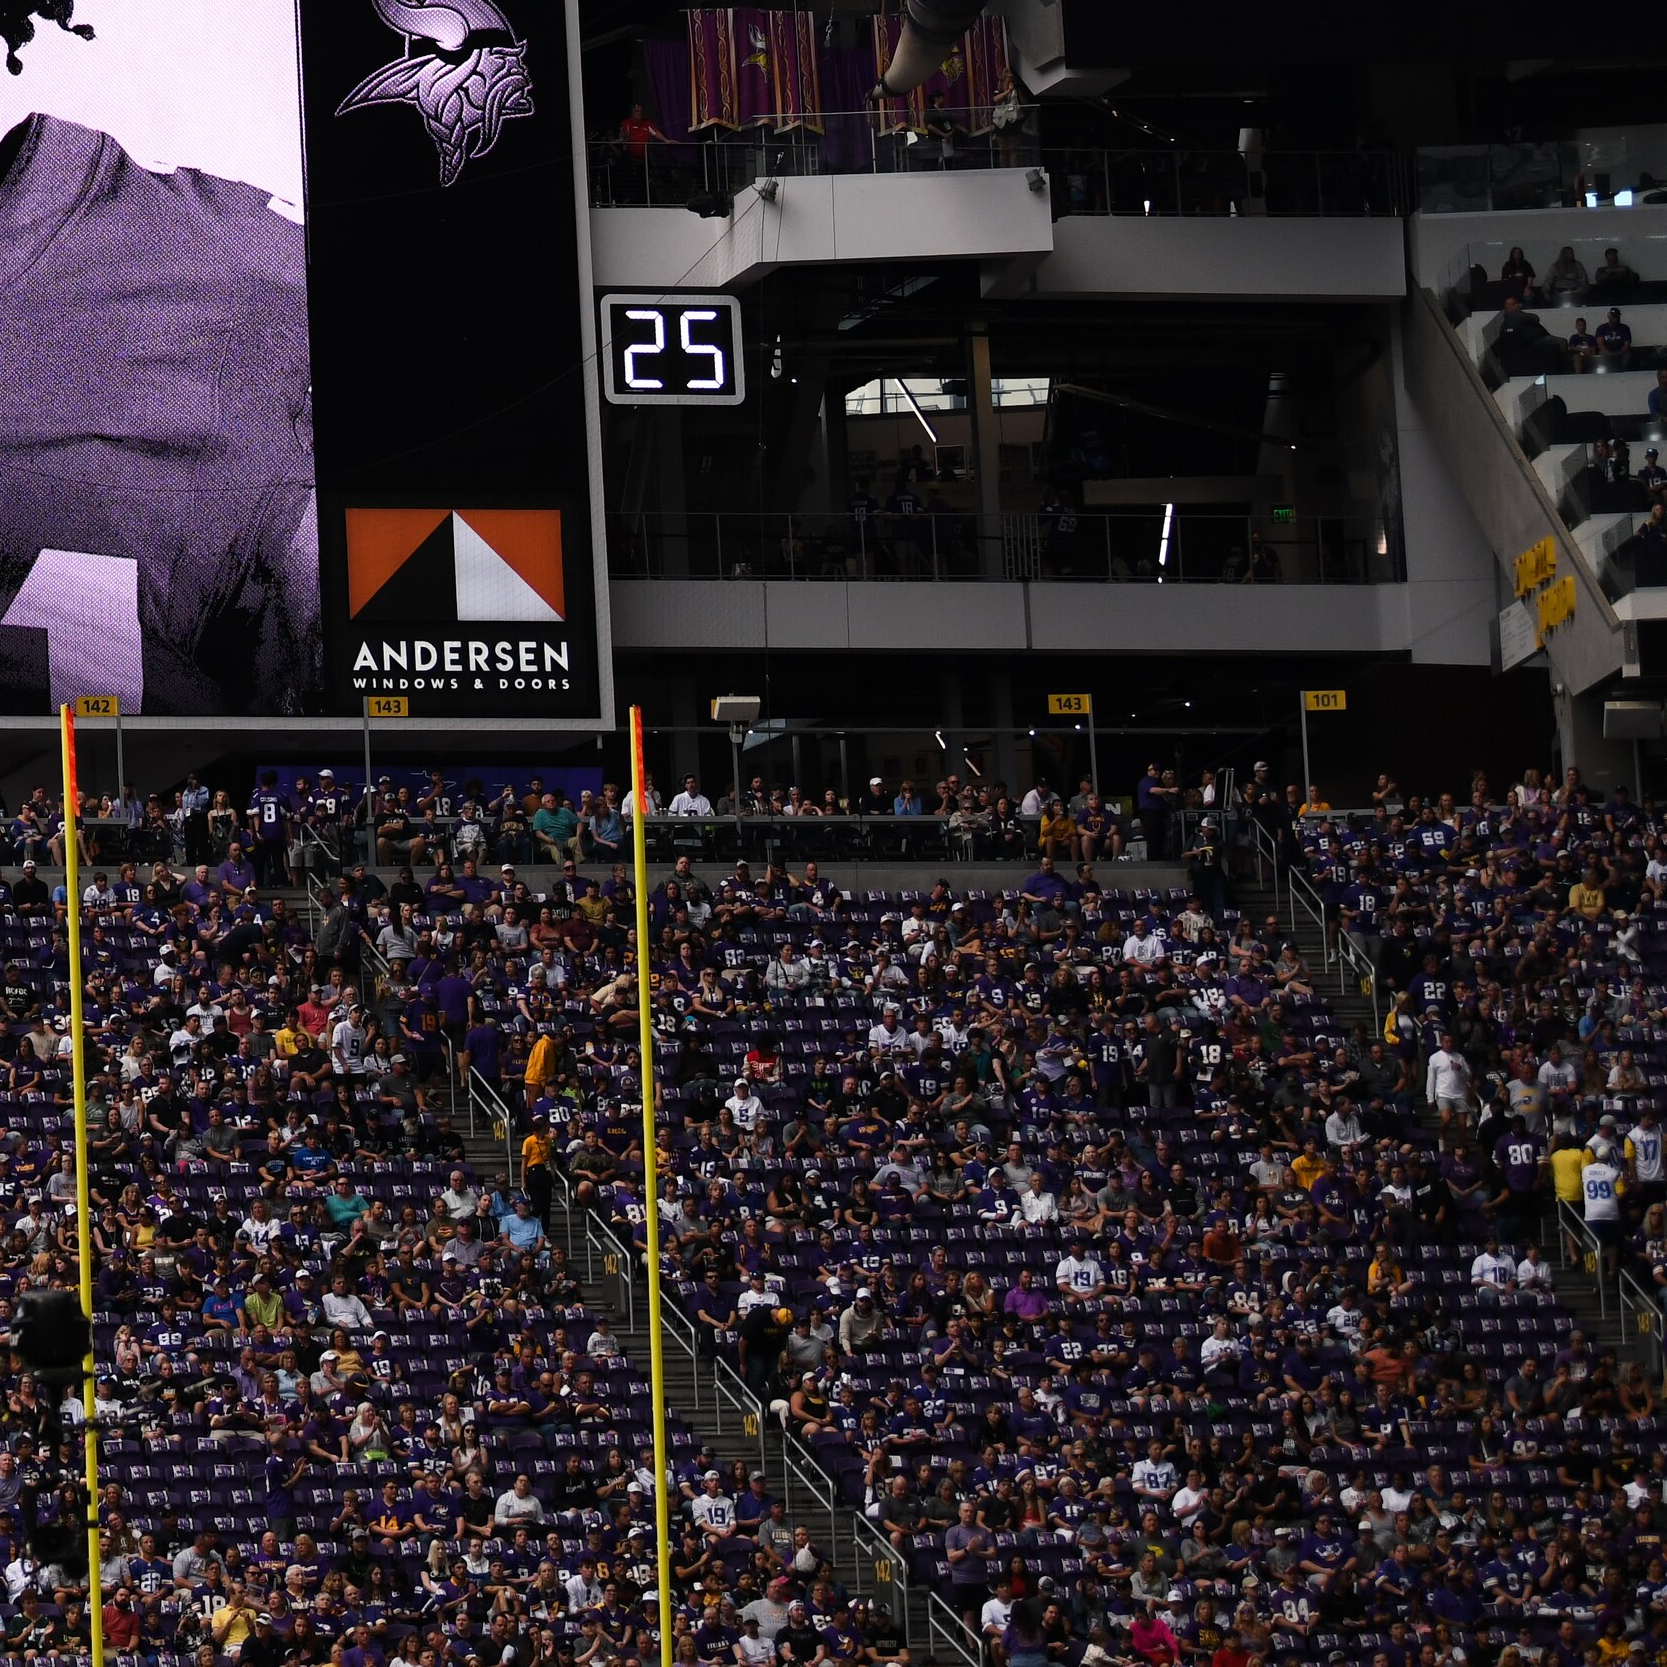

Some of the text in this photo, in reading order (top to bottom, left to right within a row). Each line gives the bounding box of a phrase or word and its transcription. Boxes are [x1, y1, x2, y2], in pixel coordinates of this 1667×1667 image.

[623, 310, 725, 390] 25
[352, 640, 570, 672] ANDERSEN
[353, 678, 570, 690] WINDOWS & DOORS
[83, 699, 110, 714] 142
[375, 699, 402, 714] 143
[1055, 696, 1081, 711] 143
[1312, 693, 1338, 707] 101
[434, 797, 450, 816] 18
[1331, 866, 1346, 882] 19
[125, 888, 139, 901] 18
[1358, 895, 1374, 910] 18
[1422, 982, 1445, 999] 22
[1101, 1045, 1118, 1061] 19
[1199, 1045, 1221, 1063] 18
[549, 1107, 569, 1123] 80
[1507, 1144, 1532, 1165] 80
[1641, 1141, 1657, 1160] 17
[1587, 1179, 1611, 1199] 99
[1110, 1270, 1127, 1284] 18
[1492, 1266, 1508, 1283] 18
[1234, 1290, 1258, 1311] 84
[1060, 1343, 1082, 1359] 22
[378, 1515, 399, 1531] 14
